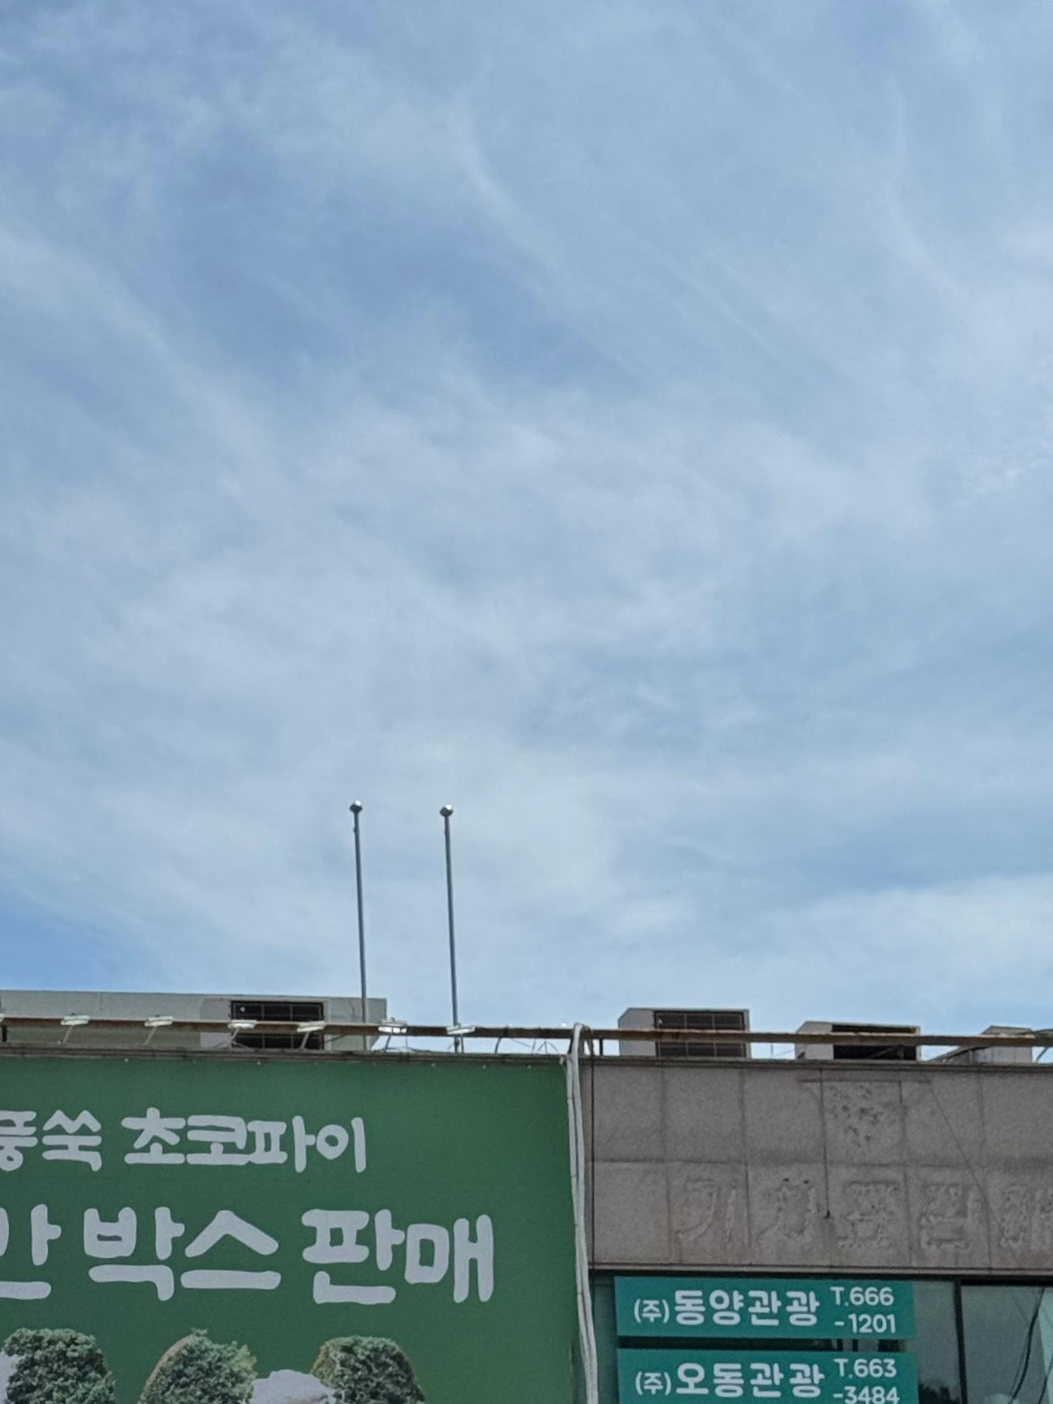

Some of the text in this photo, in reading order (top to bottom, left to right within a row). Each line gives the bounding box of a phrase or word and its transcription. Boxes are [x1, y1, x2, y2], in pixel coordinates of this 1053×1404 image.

[121, 1107, 367, 1173] 초코파이
[83, 1206, 282, 1301] 박스
[301, 1208, 495, 1305] 판매
[829, 1286, 895, 1307] T.666
[833, 1357, 898, 1379] T.663
